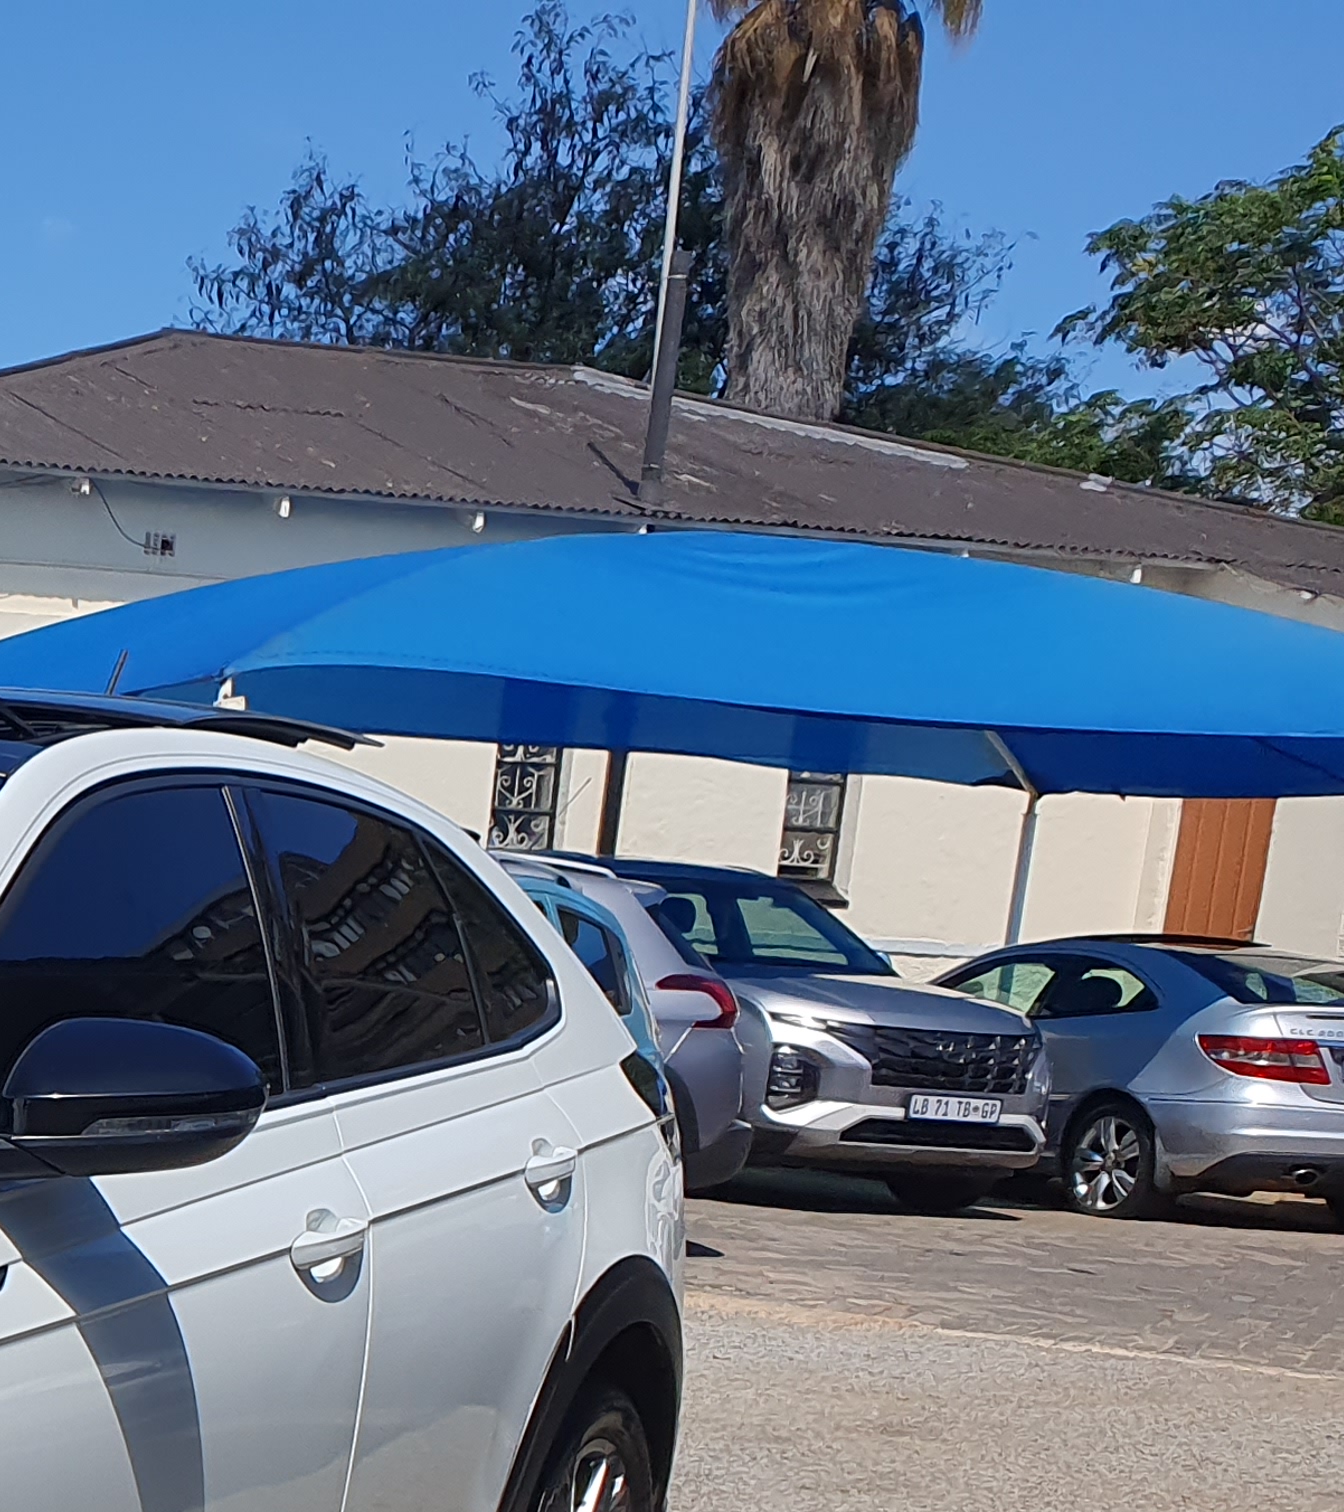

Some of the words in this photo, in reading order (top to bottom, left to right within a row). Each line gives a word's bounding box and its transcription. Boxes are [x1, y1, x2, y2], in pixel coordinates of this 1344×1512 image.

[912, 1098, 929, 1115] LB
[934, 1099, 949, 1117] 71
[956, 1101, 971, 1117] TB
[981, 1103, 997, 1119] GP
